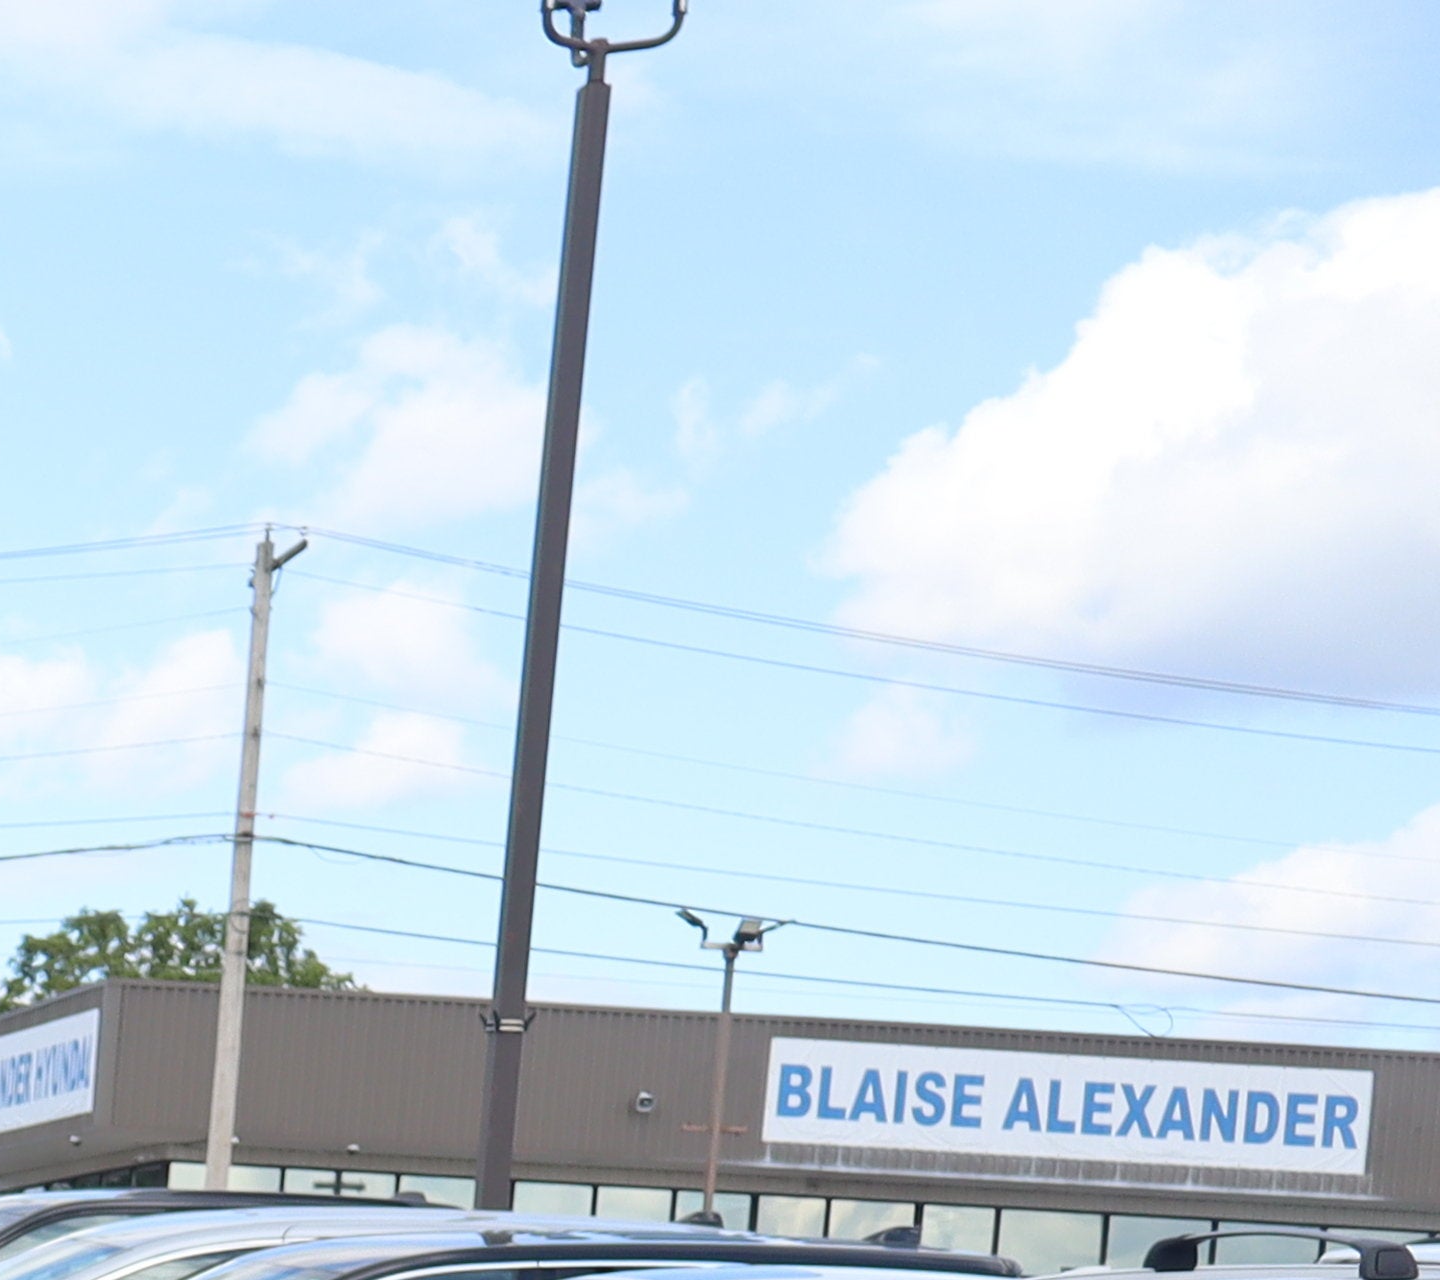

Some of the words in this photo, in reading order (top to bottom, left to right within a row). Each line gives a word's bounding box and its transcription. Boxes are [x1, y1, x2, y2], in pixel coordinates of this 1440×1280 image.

[32, 1033, 93, 1101] HYUNDAI
[776, 1063, 985, 1128] BLAISE
[1002, 1077, 1360, 1150] ALEXANDER
